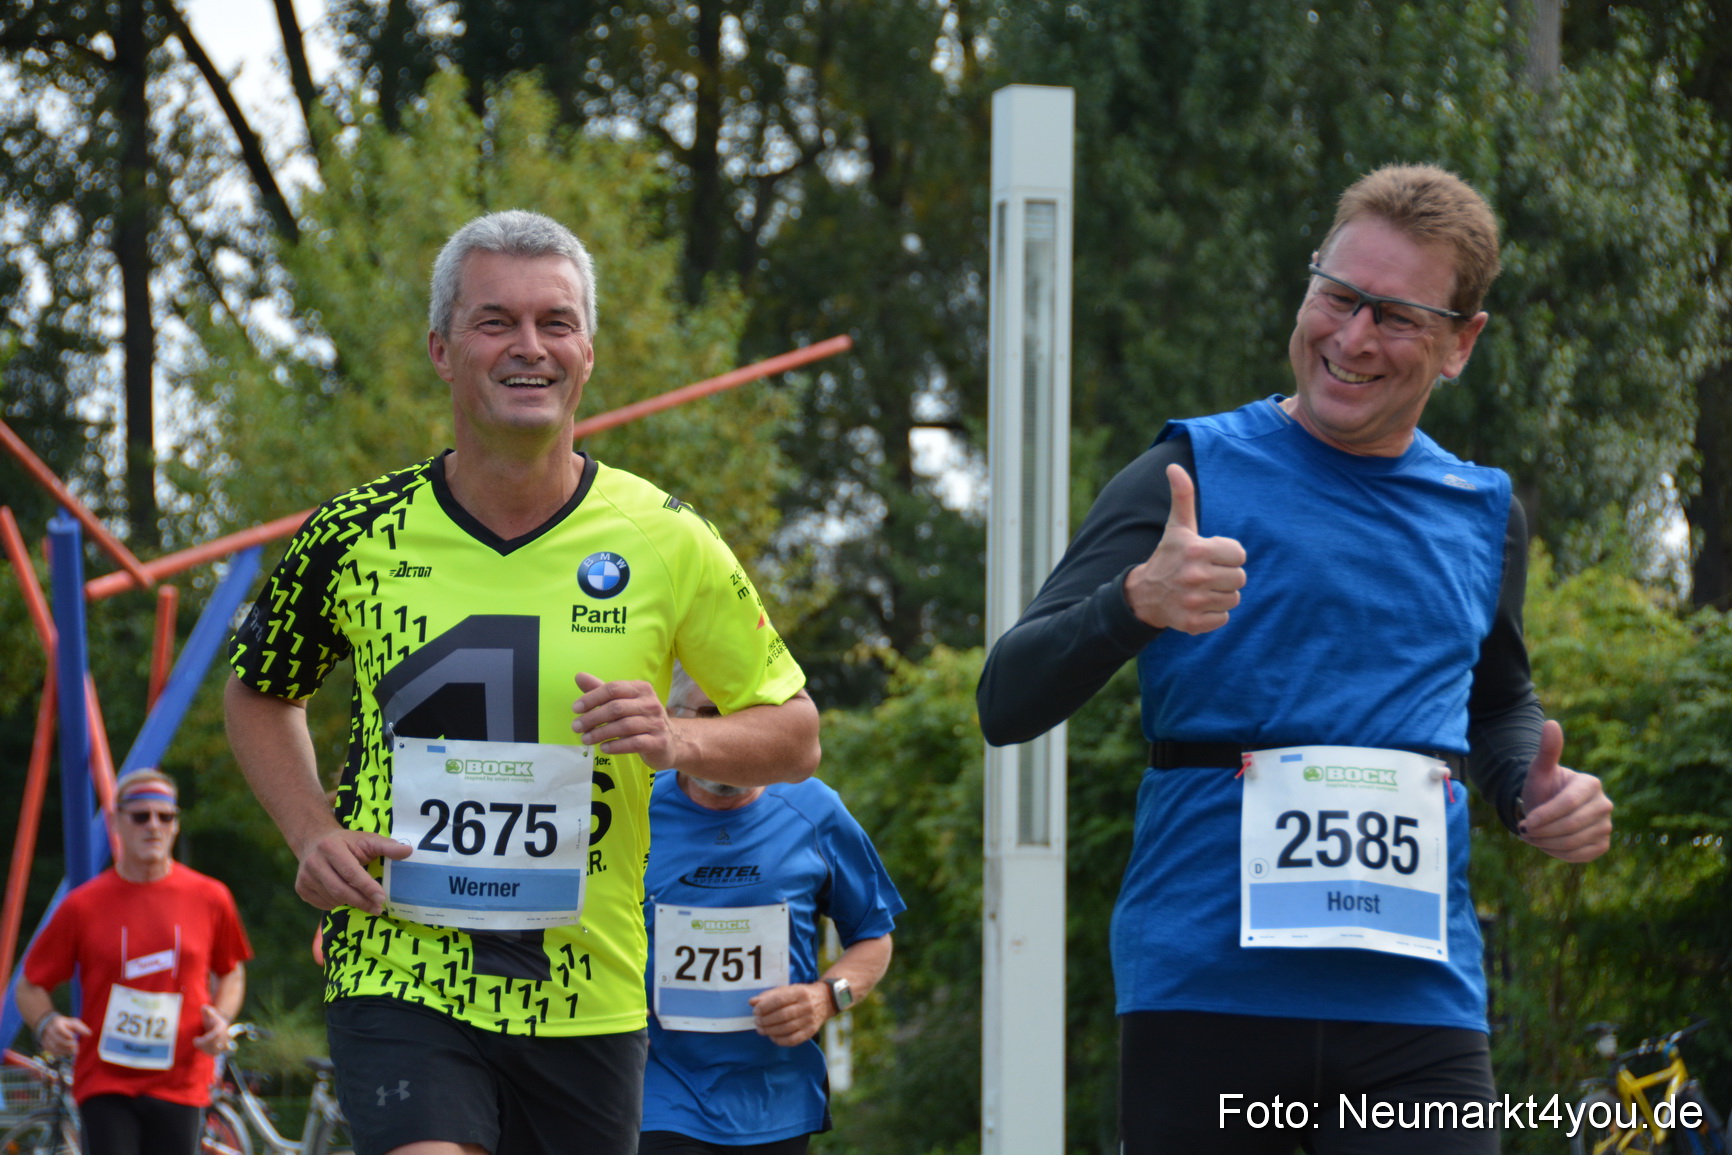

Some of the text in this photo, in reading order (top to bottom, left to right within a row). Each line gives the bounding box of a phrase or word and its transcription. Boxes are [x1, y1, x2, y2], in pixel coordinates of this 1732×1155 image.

[584, 553, 627, 569] BMW
[572, 604, 627, 624] Partl
[571, 623, 626, 634] Neumarkt
[465, 759, 533, 777] BOCK
[1325, 766, 1398, 786] BOCK
[417, 799, 558, 857] 2675
[1275, 810, 1420, 875] 2585
[693, 866, 761, 878] ERTEL
[449, 875, 521, 897] Werner
[1327, 891, 1381, 914] Horst
[704, 919, 750, 930] BOCK
[675, 945, 762, 982] 2751
[116, 1011, 167, 1039] 2512
